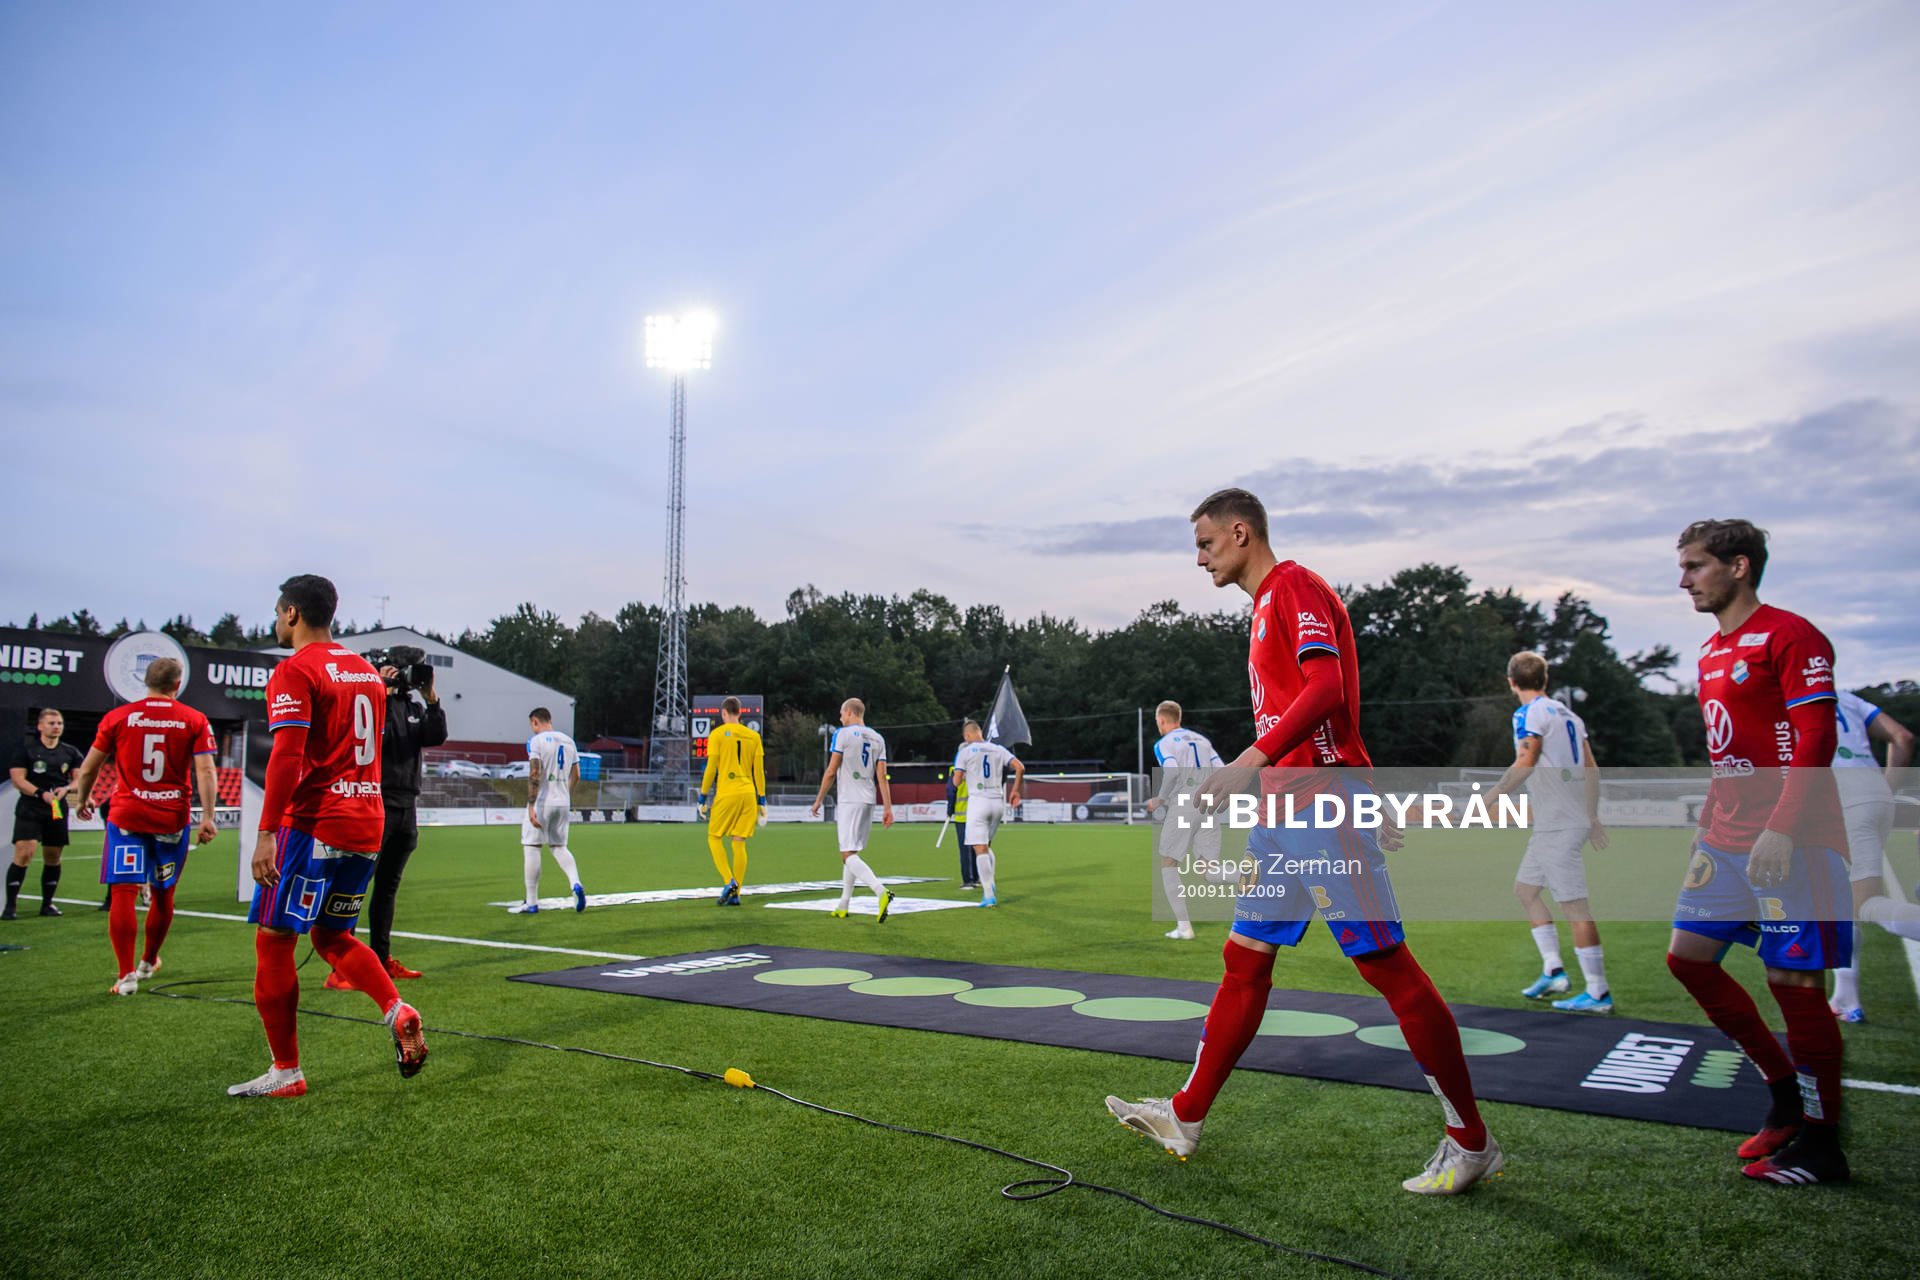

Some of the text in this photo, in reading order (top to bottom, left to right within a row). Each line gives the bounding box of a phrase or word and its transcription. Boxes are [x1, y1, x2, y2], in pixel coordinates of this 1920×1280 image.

[1297, 611, 1317, 622] ICA
[208, 663, 275, 688] UNIB
[276, 693, 292, 703] ICA
[354, 694, 375, 766] 9
[142, 734, 165, 783] 5
[557, 745, 564, 770] 4
[737, 740, 742, 766] 1
[862, 742, 871, 768] 5
[983, 755, 991, 779] 6
[1324, 910, 1346, 921] LCO
[1579, 1032, 1695, 1093] UNIBET
